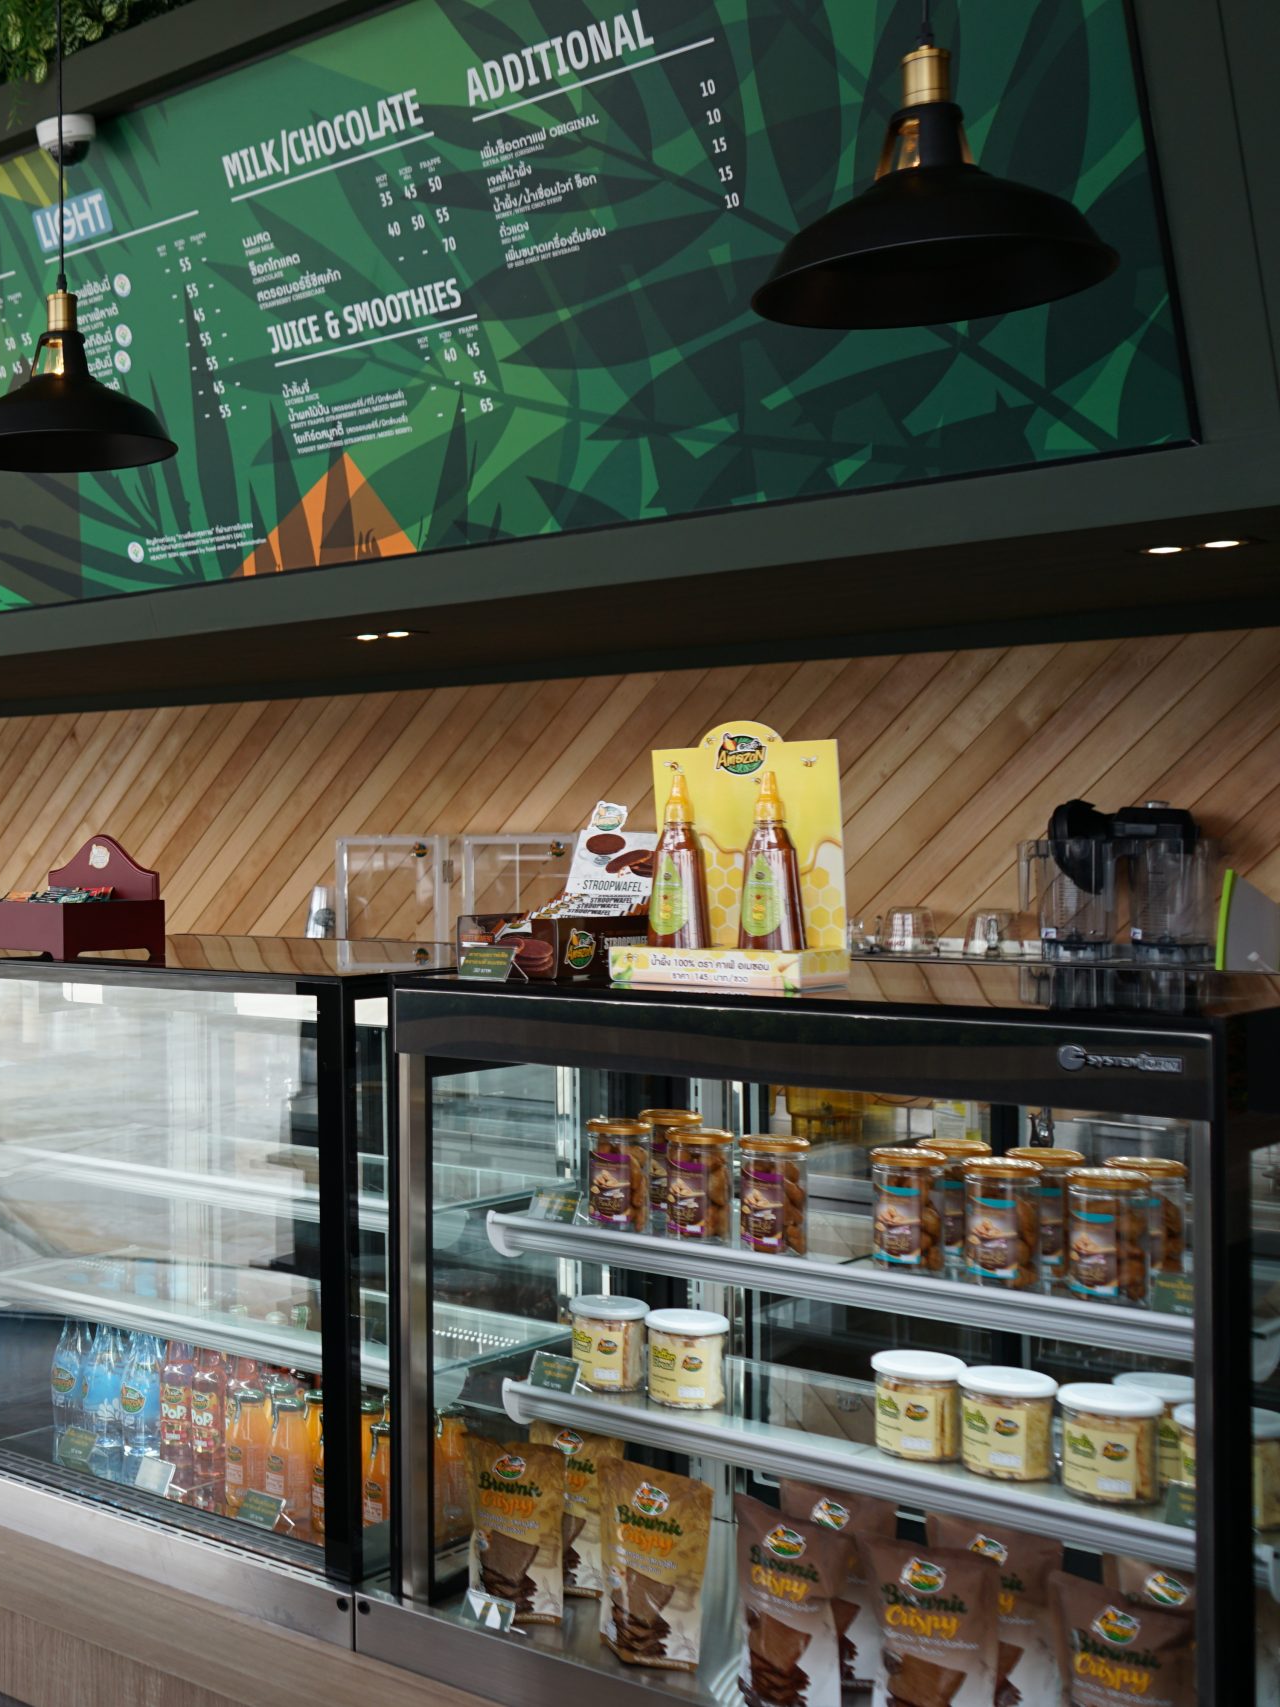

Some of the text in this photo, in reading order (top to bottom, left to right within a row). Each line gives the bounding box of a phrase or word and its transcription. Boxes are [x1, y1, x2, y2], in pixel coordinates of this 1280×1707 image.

[466, 8, 655, 106] ADDITIONAL
[700, 78, 716, 98] 10
[550, 114, 600, 138] ORIGINAL
[706, 108, 722, 126] 10
[222, 88, 424, 188] MILK/CHOCOLATE
[712, 136, 728, 154] 15
[718, 165, 733, 183] 15
[379, 175, 442, 208] 35 45 50
[724, 192, 740, 210] 10
[36, 193, 107, 249] LIGHT
[388, 206, 450, 238] 40 50 55
[242, 231, 271, 248] นมสด
[442, 236, 457, 253] 70
[179, 257, 192, 272] 55
[186, 283, 199, 298] 55
[194, 307, 206, 322] 45
[266, 277, 462, 354] JUICE & SMOOTHIES
[5, 337, 16, 350] 50
[22, 332, 32, 346] 55
[200, 332, 212, 348] 55
[444, 342, 480, 362] 40 45
[12, 362, 22, 374] 45
[206, 356, 218, 371] 55
[473, 370, 486, 386] 55
[213, 380, 226, 395] 45
[219, 404, 232, 418] 55
[480, 397, 494, 413] 65
[582, 880, 642, 892] STROOPWAFEL
[674, 958, 695, 968] 100%
[479, 1472, 542, 1498] Brownie
[480, 1490, 536, 1518] Crispy
[617, 1506, 683, 1536] Brownie
[618, 1524, 675, 1558] Crispy
[750, 1545, 819, 1583] Brownie
[750, 1565, 810, 1602] Crispy
[884, 1605, 960, 1639] Crispy
[1074, 1651, 1152, 1695] Crispy
